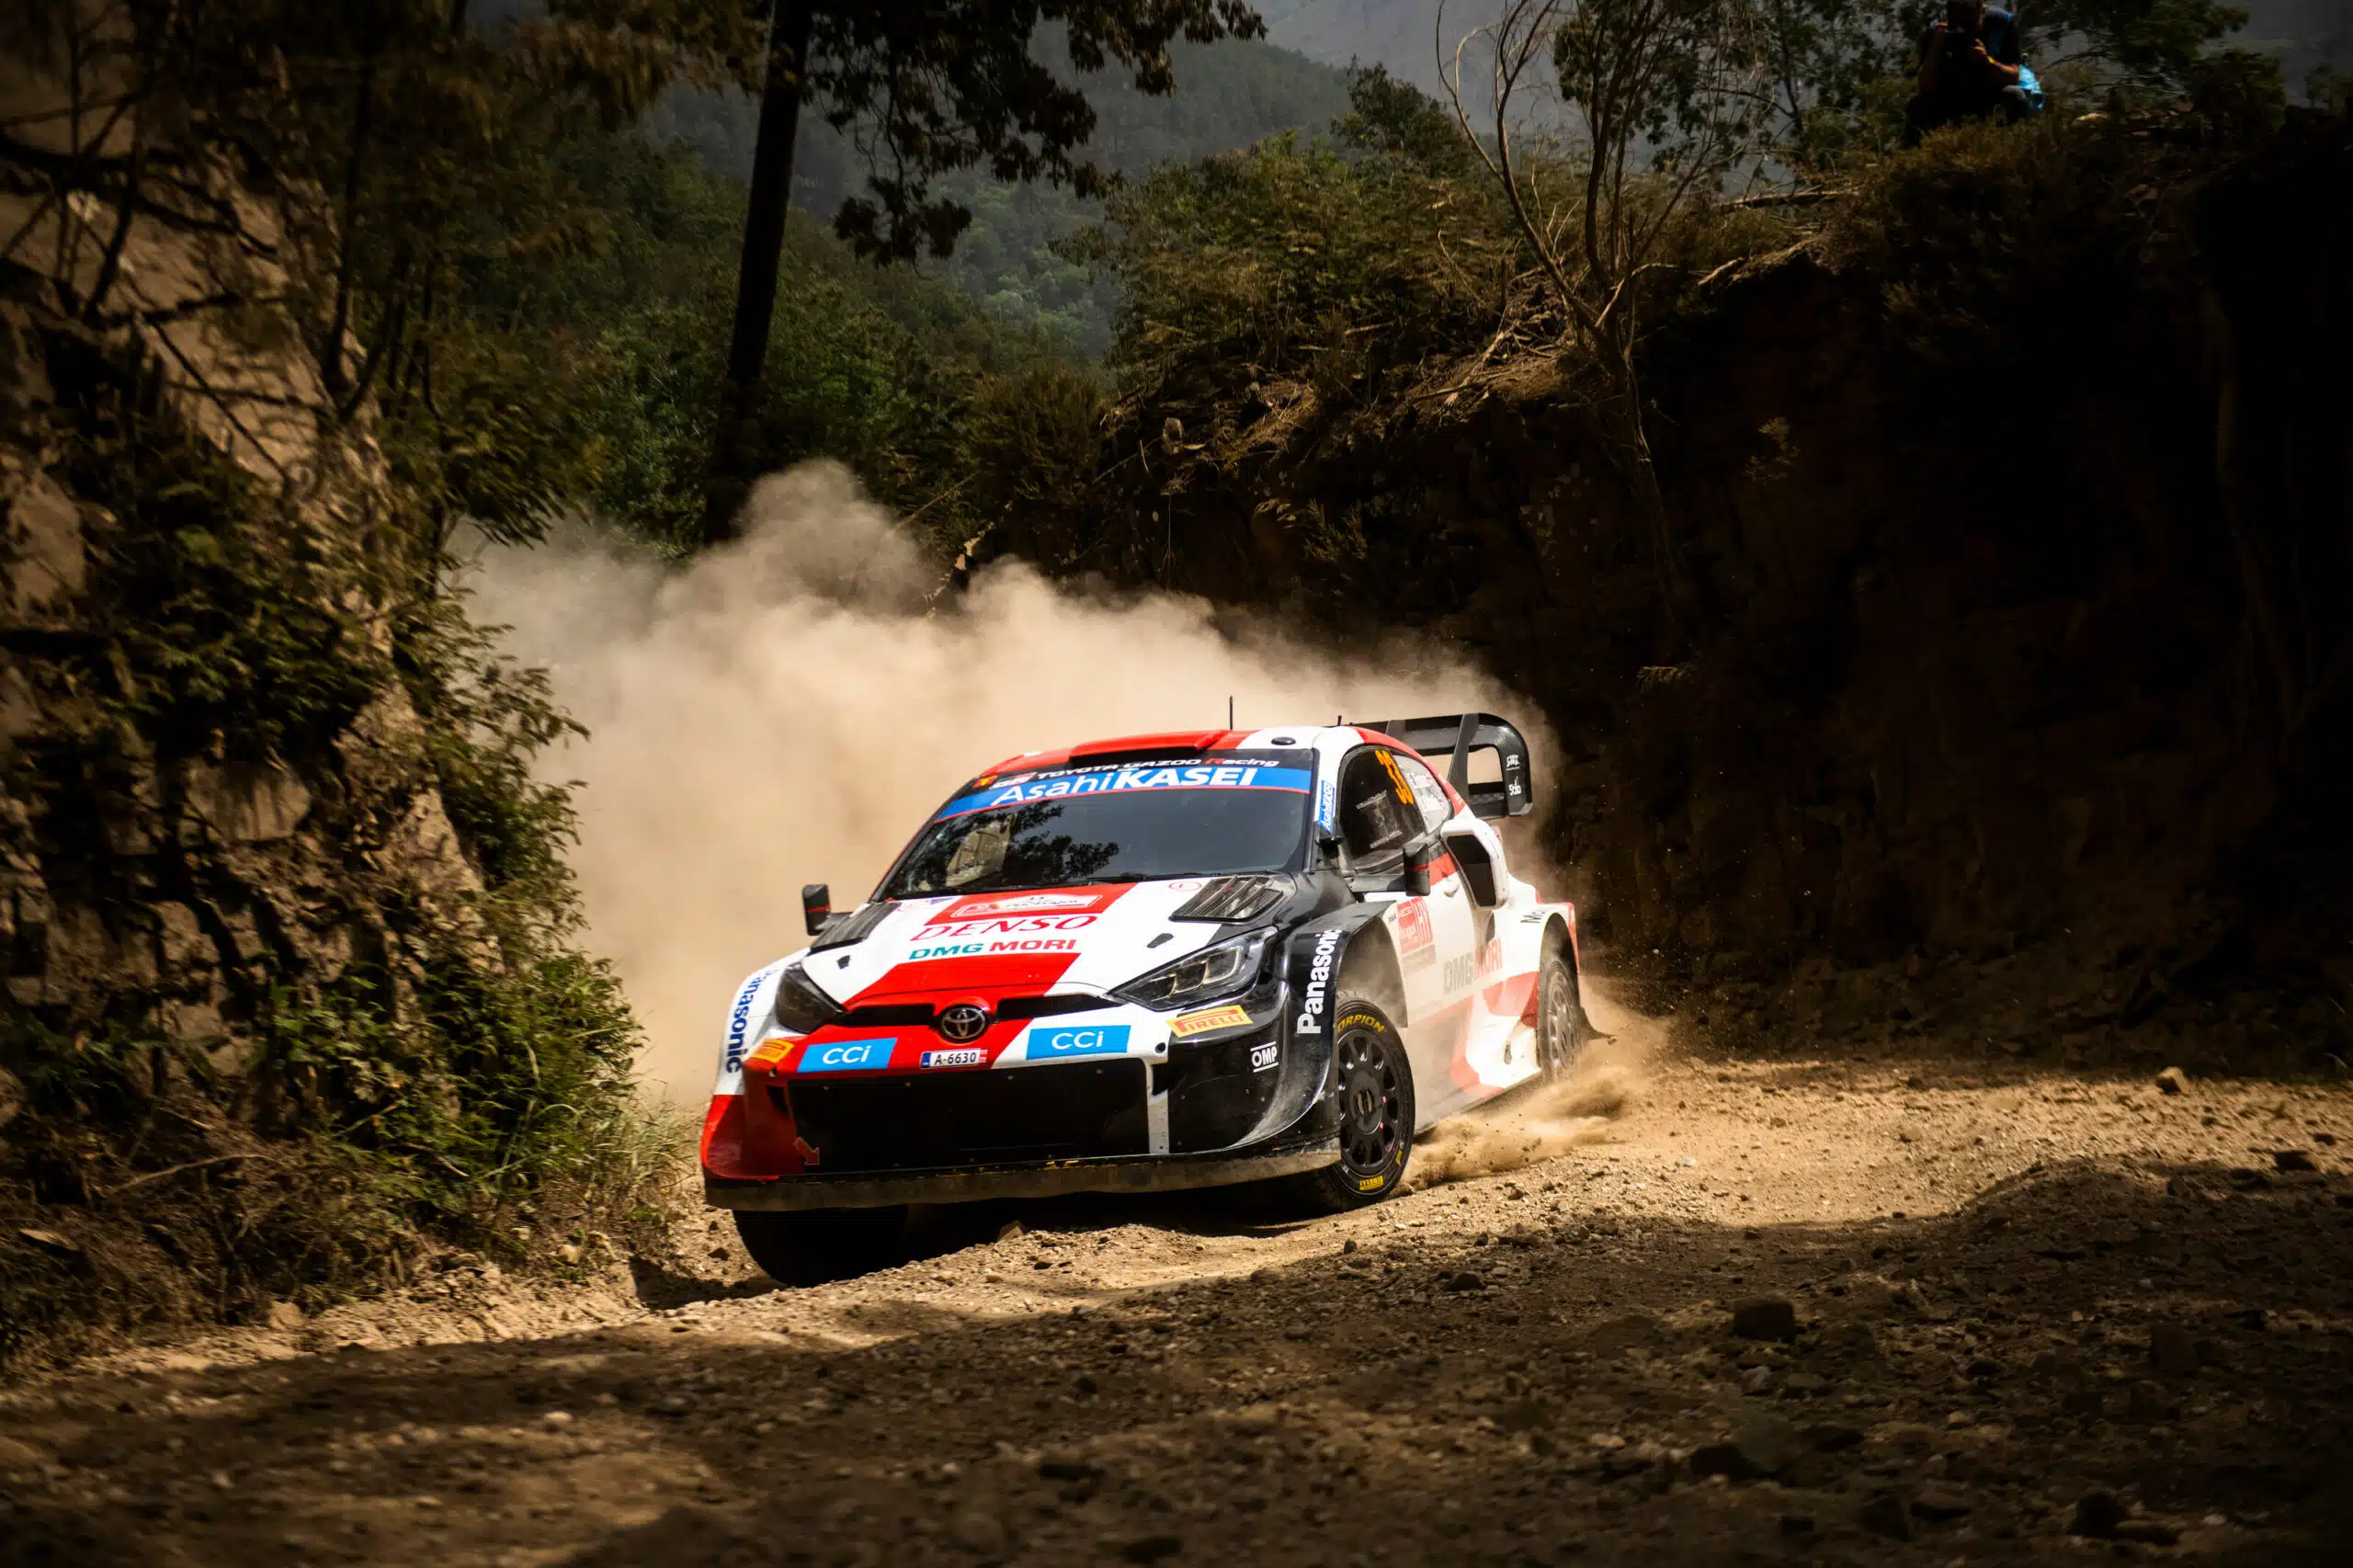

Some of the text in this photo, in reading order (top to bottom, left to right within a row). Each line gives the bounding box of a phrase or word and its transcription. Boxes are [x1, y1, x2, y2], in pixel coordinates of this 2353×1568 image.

[1038, 764, 1119, 779] TOYOTA
[1123, 758, 1202, 768] GAZOO
[1205, 757, 1280, 767] Racing
[909, 915, 1097, 942] DENSO
[908, 938, 1077, 960] DMG MORI
[1296, 929, 1343, 1034] Panasonic
[1174, 1009, 1244, 1033] PIRELLI
[1337, 1014, 1385, 1032] ORPION
[1051, 1030, 1105, 1050] CCi
[823, 1045, 872, 1065] CCi
[934, 1051, 977, 1065] A-6630
[1251, 1045, 1278, 1067] OMP
